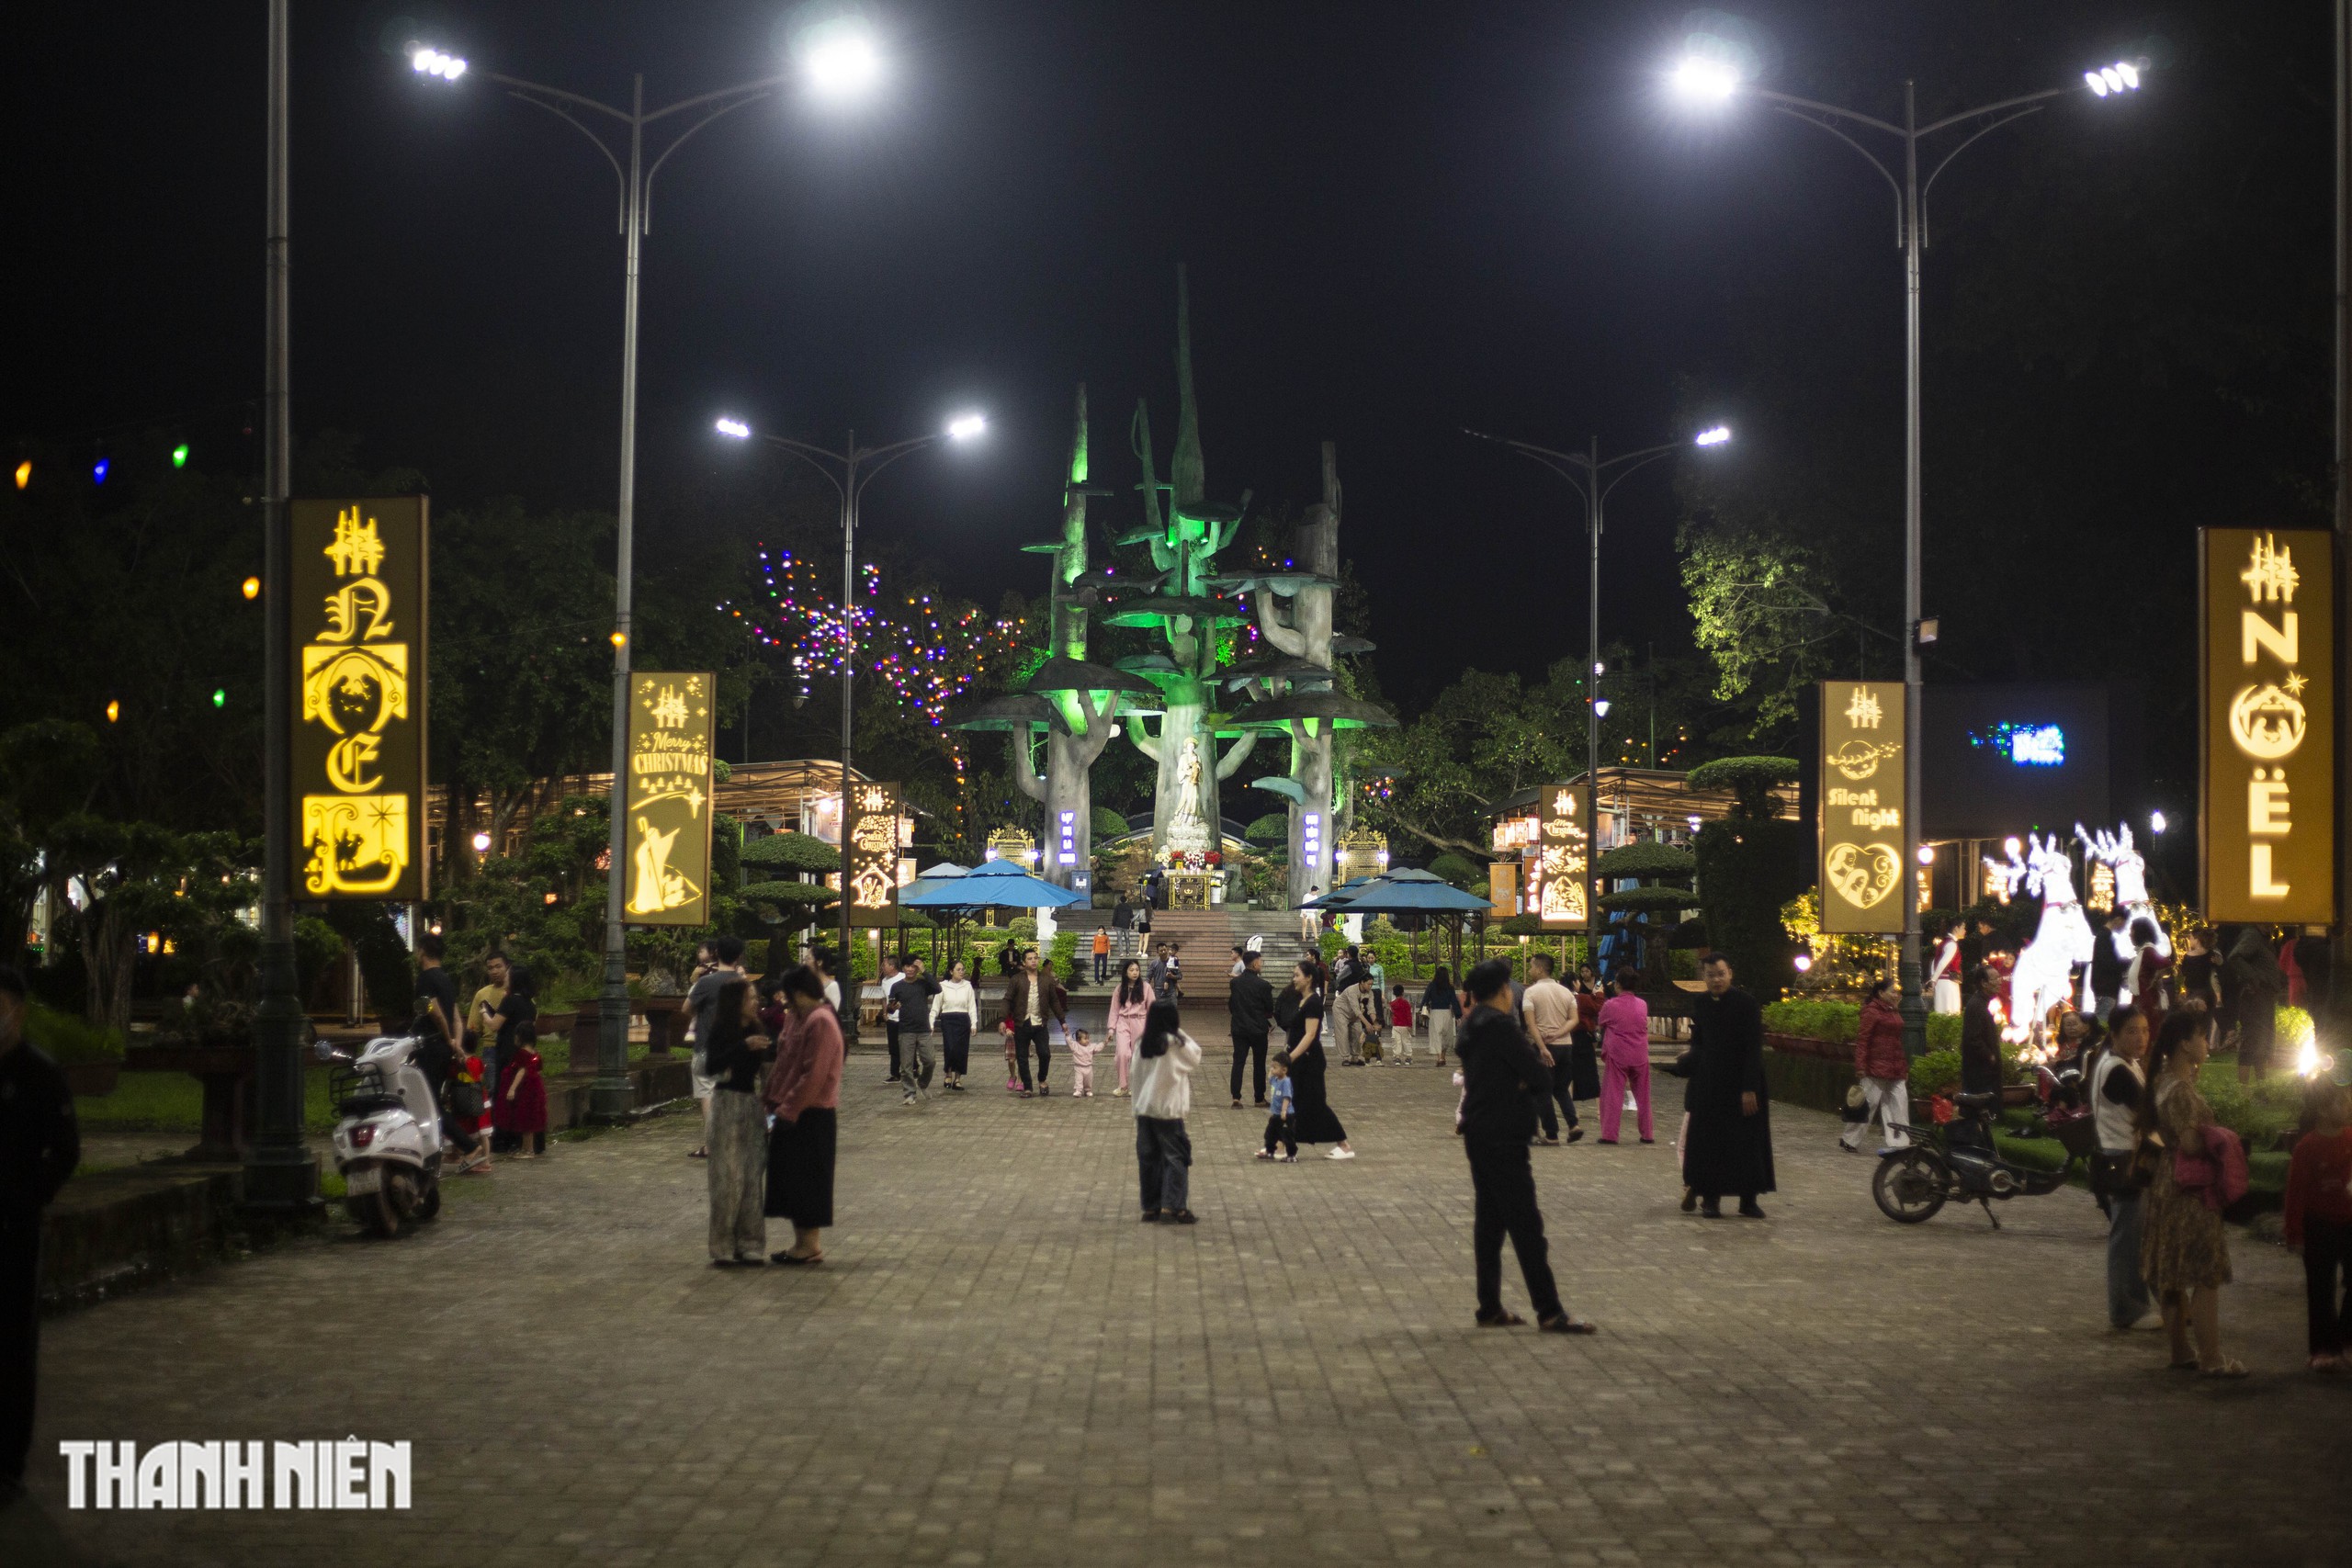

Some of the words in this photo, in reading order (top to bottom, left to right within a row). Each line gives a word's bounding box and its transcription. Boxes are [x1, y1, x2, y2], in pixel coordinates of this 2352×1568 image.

[652, 731, 691, 752] Merry
[634, 752, 708, 775] CHRISTMAS
[1828, 788, 1878, 807] Silent
[1852, 808, 1901, 831] Night
